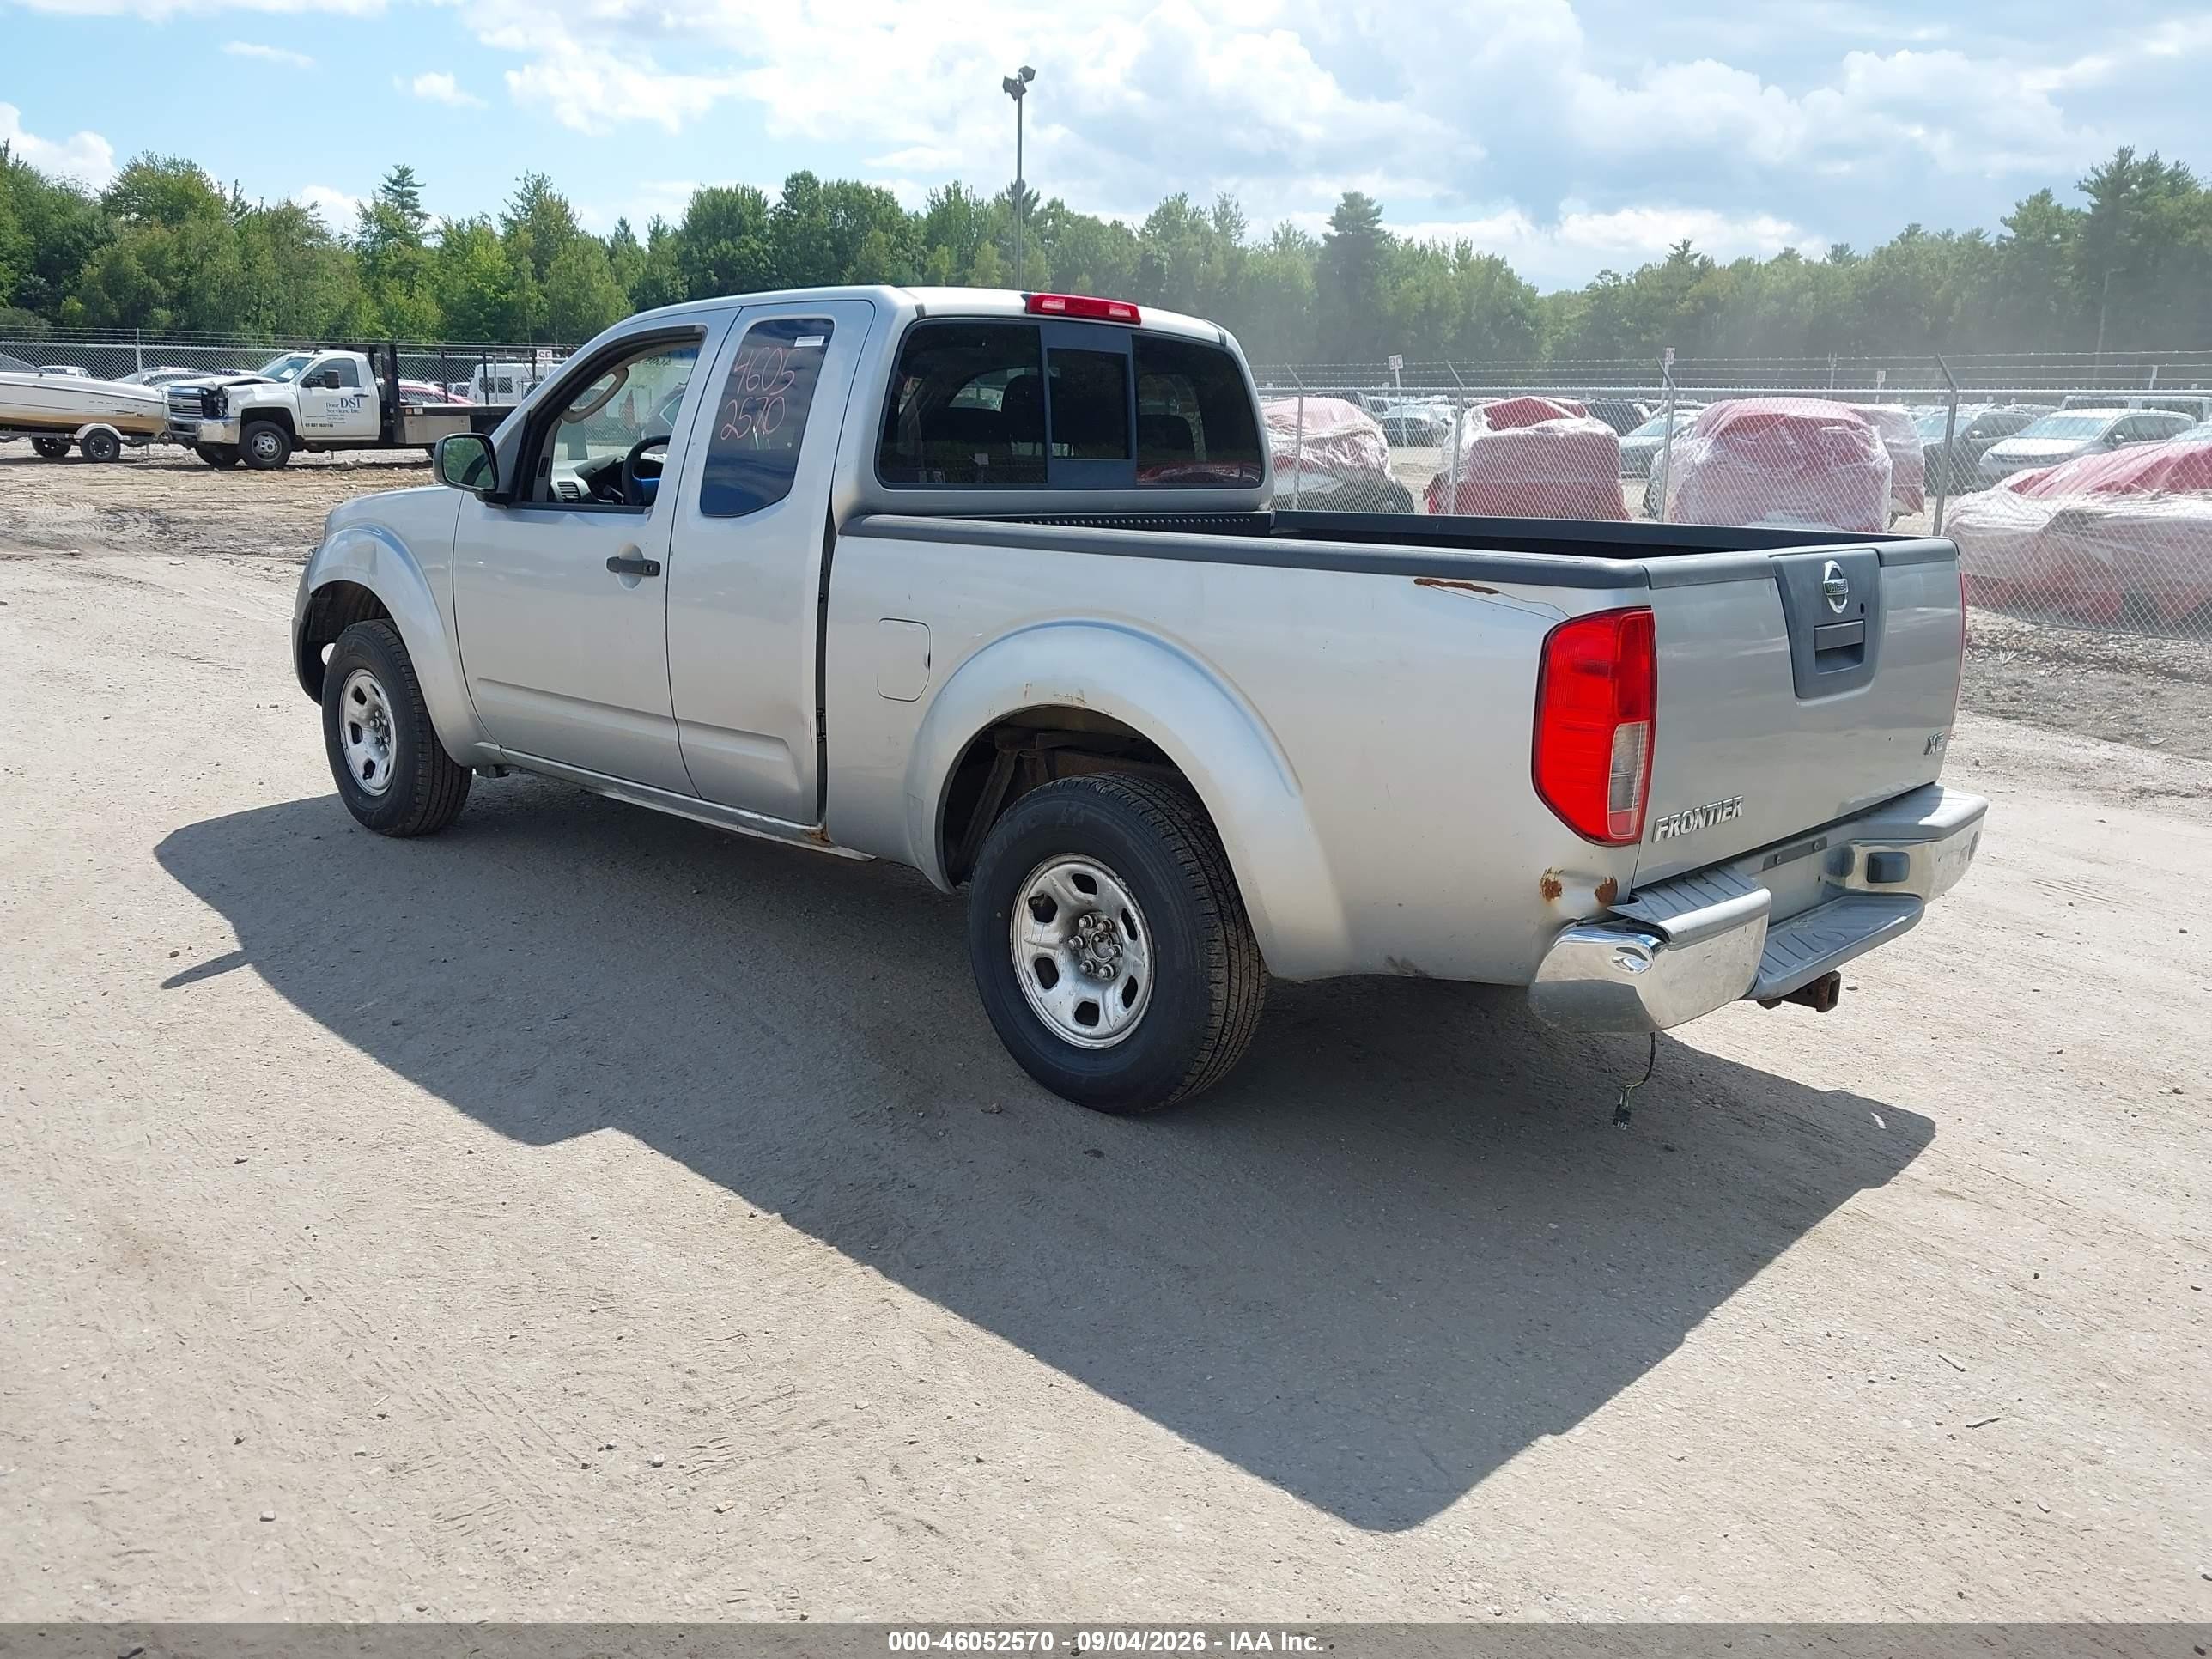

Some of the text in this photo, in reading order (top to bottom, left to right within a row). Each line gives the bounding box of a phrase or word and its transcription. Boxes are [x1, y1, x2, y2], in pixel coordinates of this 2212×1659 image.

[734, 346, 801, 396] 4605
[1390, 356, 1402, 368] BC
[340, 398, 362, 409] DSI
[720, 396, 786, 441] 2570
[1651, 795, 1745, 843] FRONTIER
